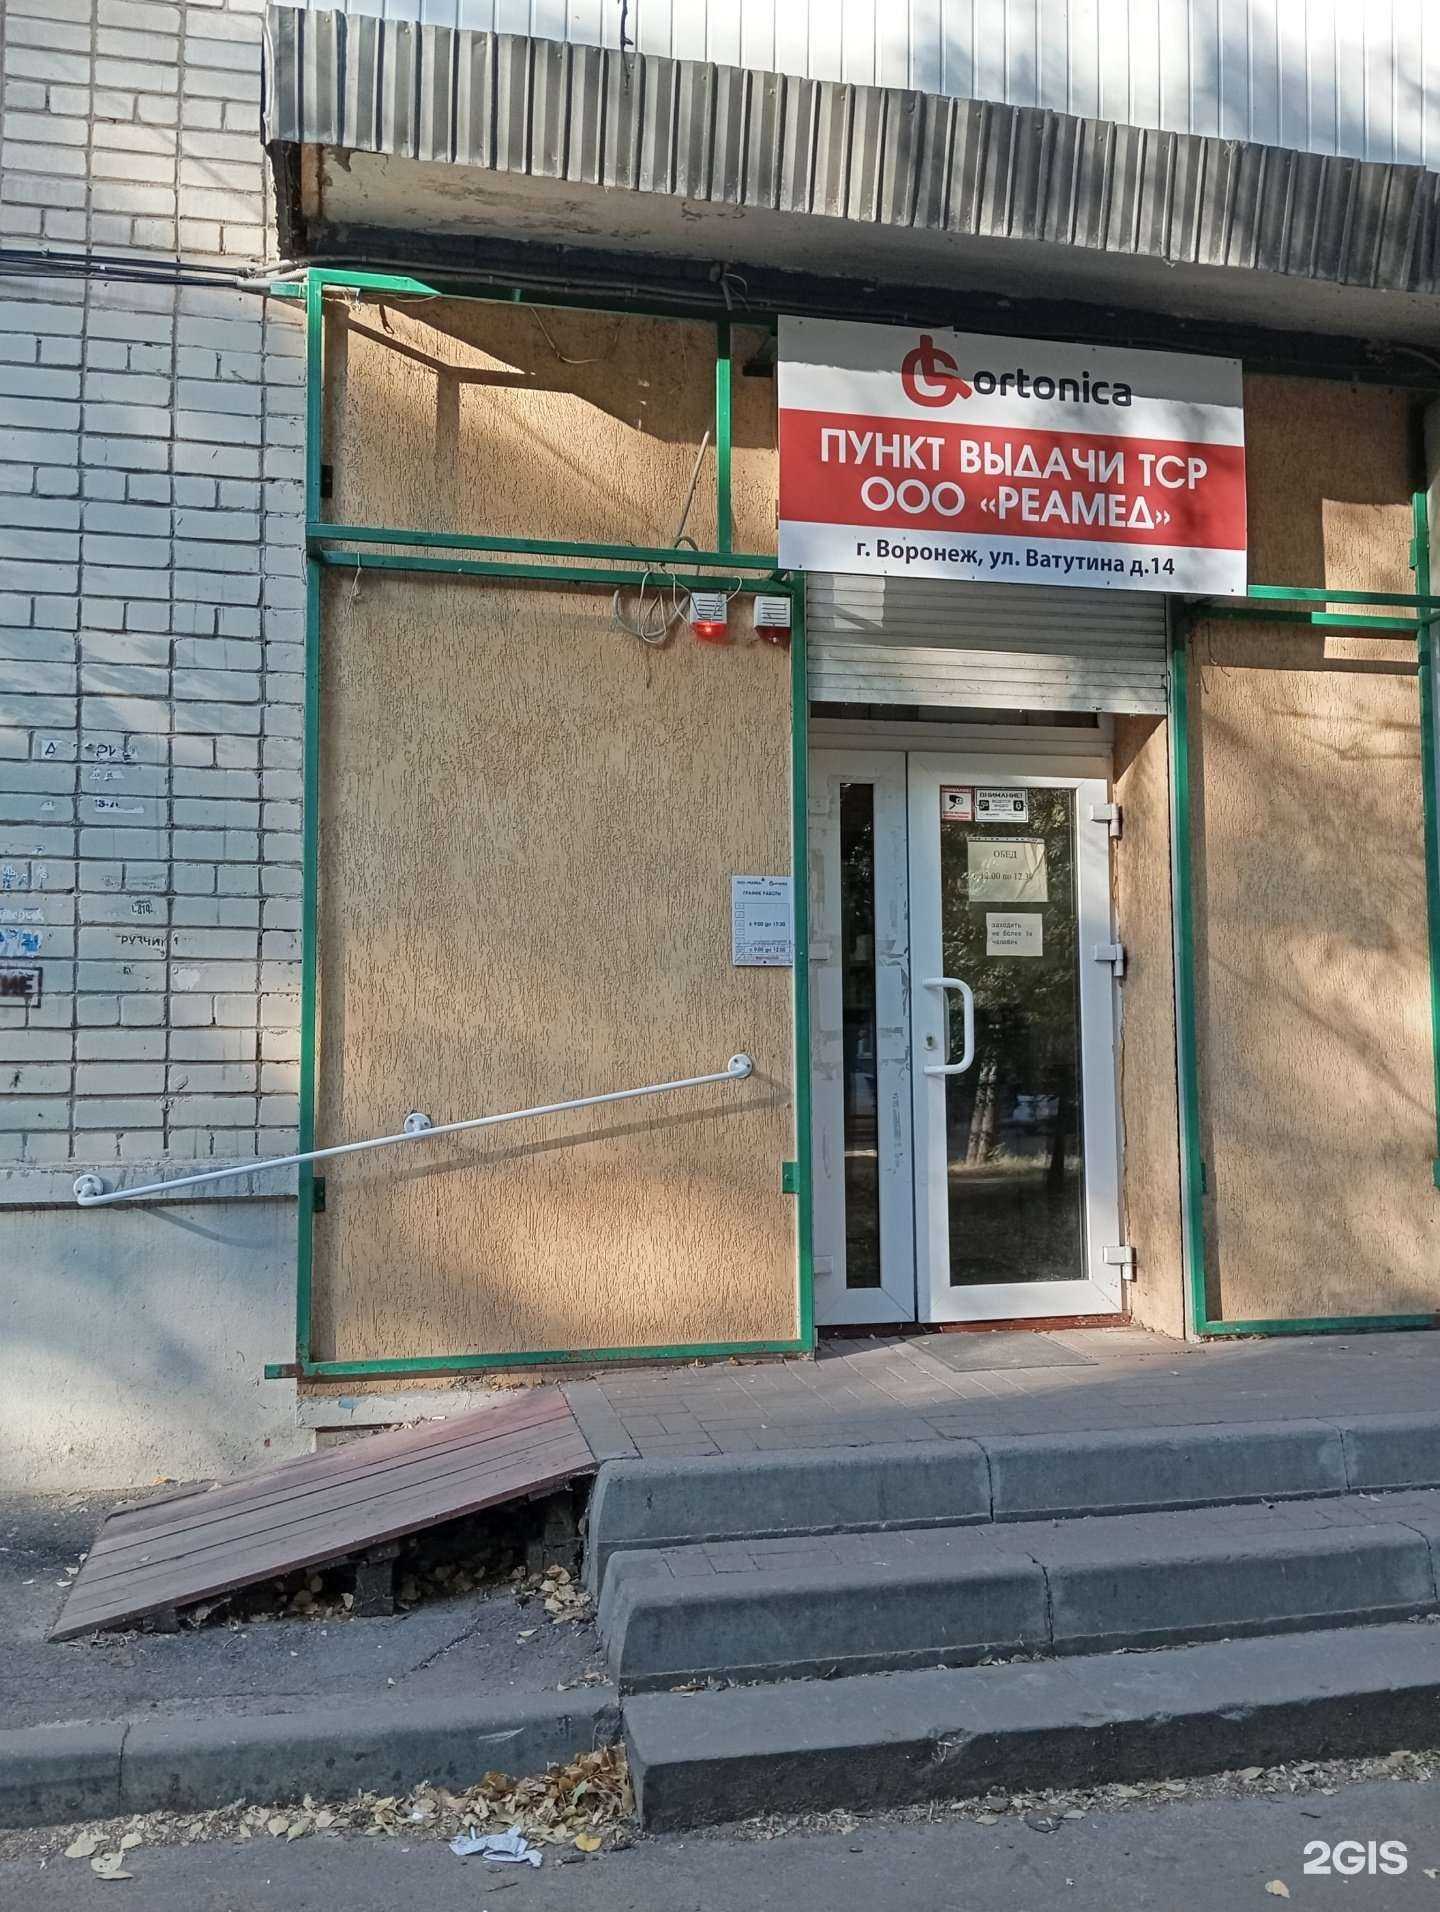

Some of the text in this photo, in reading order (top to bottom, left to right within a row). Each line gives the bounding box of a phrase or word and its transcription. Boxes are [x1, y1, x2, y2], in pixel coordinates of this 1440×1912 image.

[973, 367, 1132, 406] ortonica
[820, 428, 1208, 490] ПУНКТ ВЫДАЧИ ТСР
[861, 476, 1171, 530] ООО «РЕАМЕД»
[856, 539, 1175, 578] г. Воронеж, ул. Ватутина д.14
[993, 850, 1017, 859] ОБЕД
